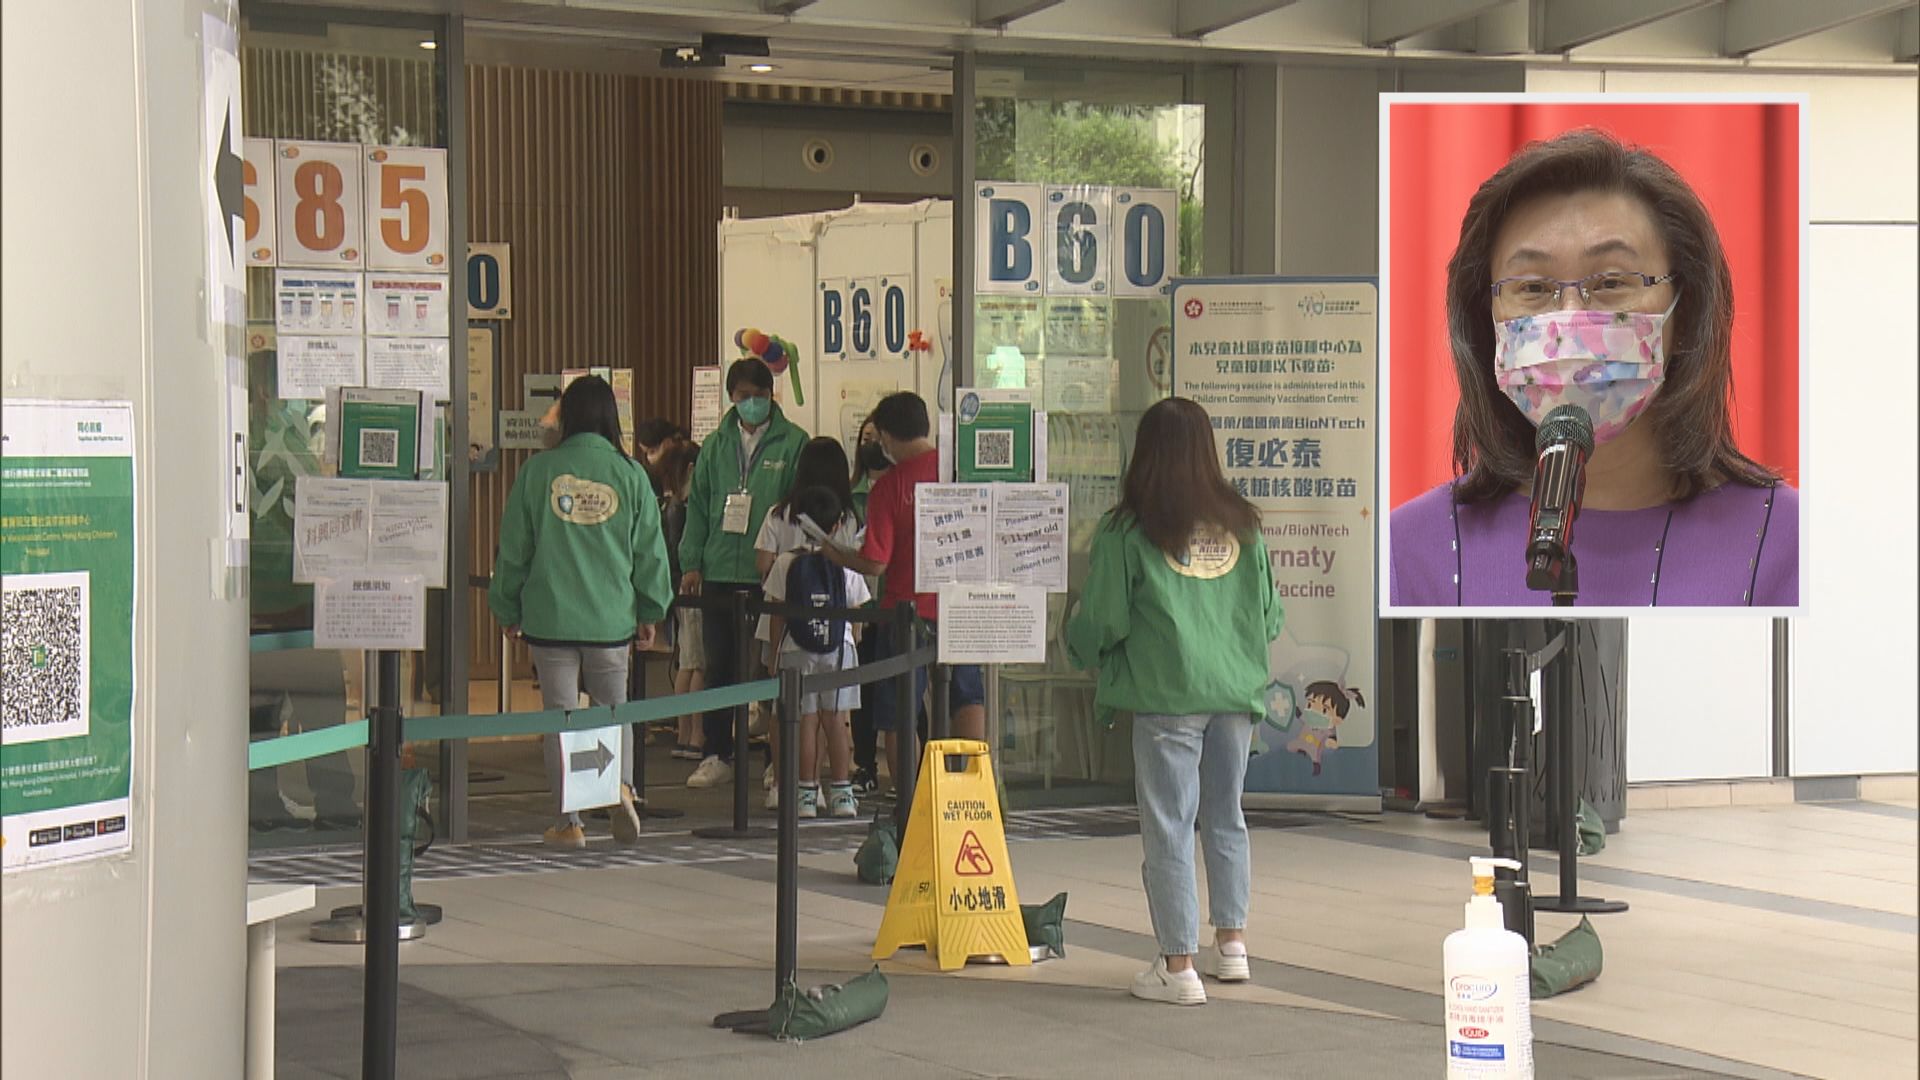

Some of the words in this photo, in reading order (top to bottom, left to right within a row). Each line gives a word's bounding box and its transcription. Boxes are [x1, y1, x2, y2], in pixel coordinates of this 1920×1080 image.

[989, 199, 1165, 287] B60
[824, 286, 905, 354] B60
[1189, 339, 1363, 356] 本兒童社區疫苗接種中心為
[1185, 381, 1199, 390] The
[1200, 381, 1240, 392] following
[1241, 382, 1272, 390] vaccine
[1273, 381, 1281, 390] is
[1282, 381, 1338, 390] administered
[1339, 381, 1347, 390] in
[1348, 381, 1365, 390] this
[1229, 394, 1276, 405] Community
[1277, 394, 1326, 404] Vaccination
[1327, 394, 1359, 404] Centre:
[1226, 438, 1322, 468] 復必泰
[1044, 521, 1058, 534] old
[968, 591, 988, 600] Points
[989, 591, 998, 600] to
[1000, 592, 1016, 600] note
[947, 800, 985, 811] CAUTION
[943, 811, 962, 821] WET
[964, 811, 993, 821] FLOOR
[949, 885, 1006, 911] 小心地滑
